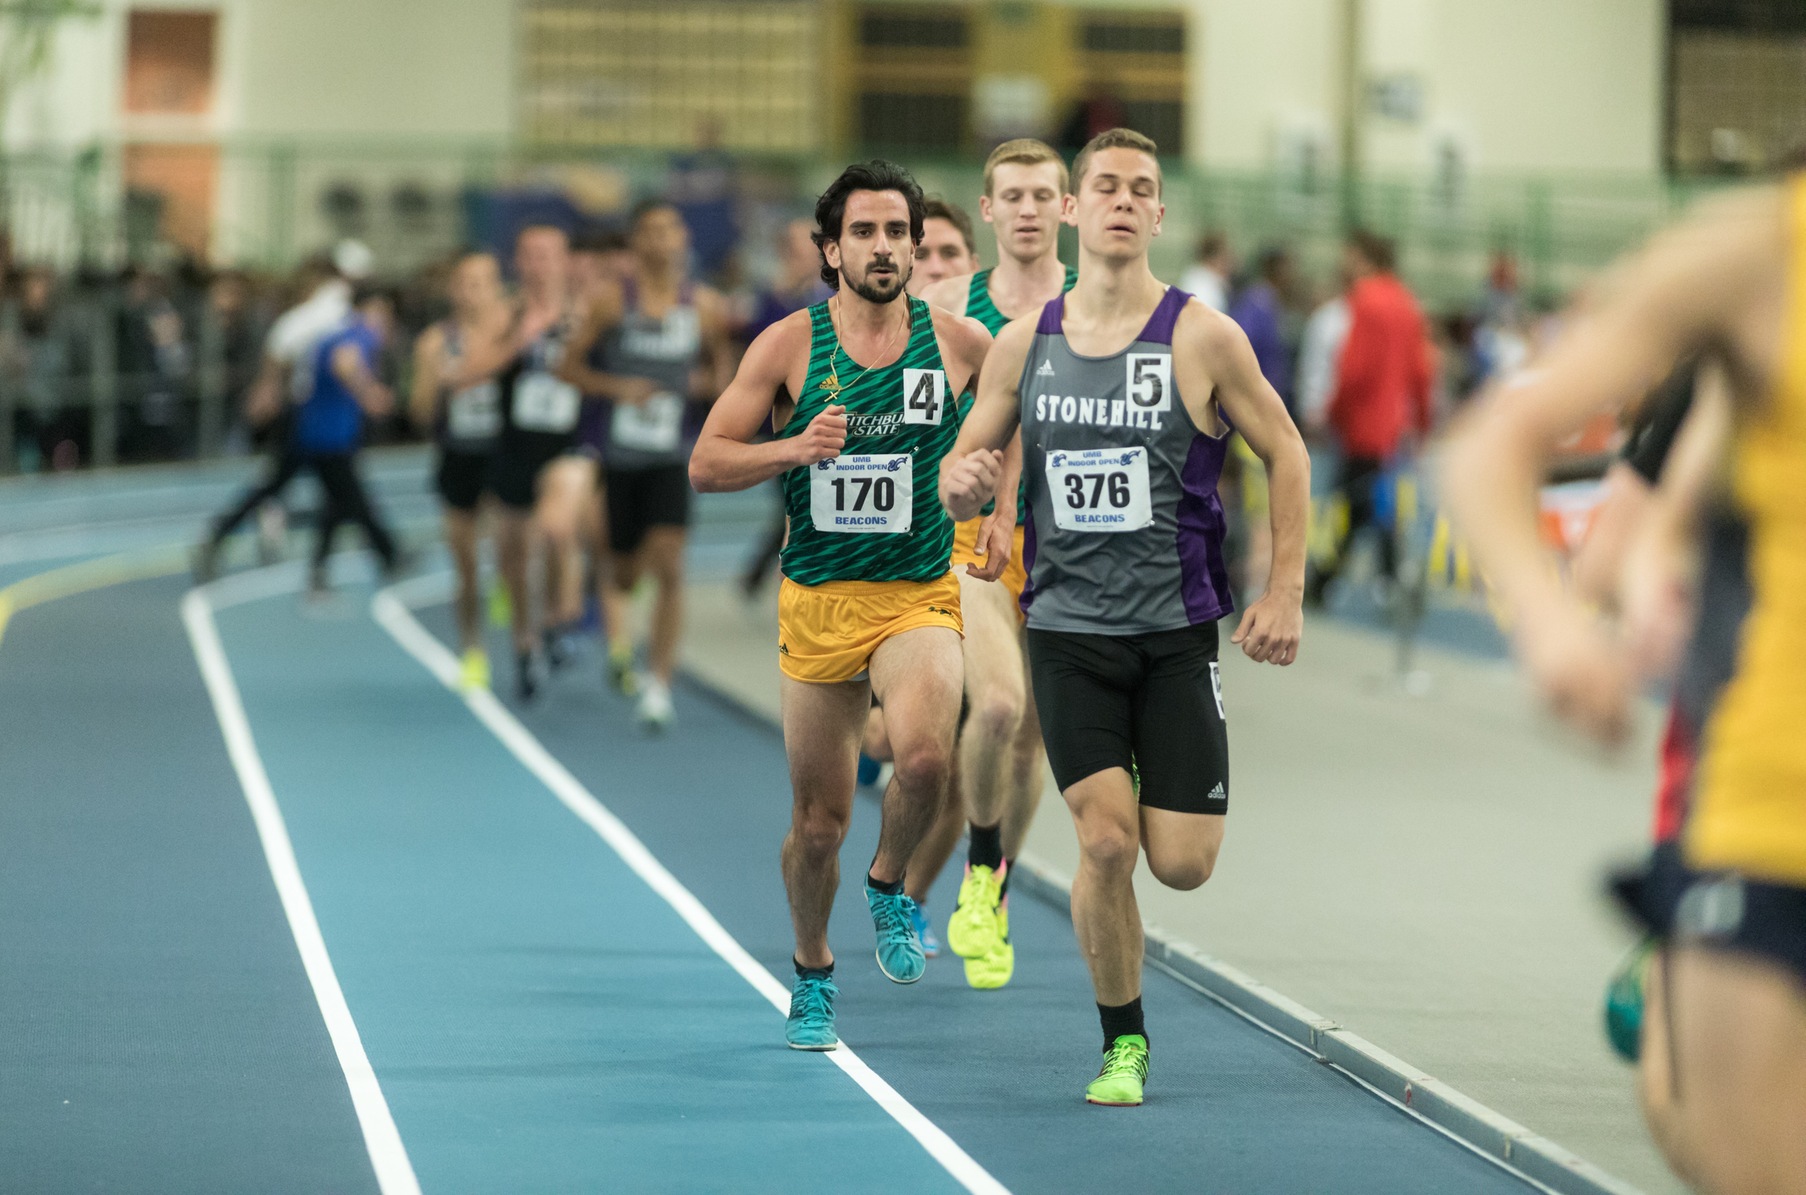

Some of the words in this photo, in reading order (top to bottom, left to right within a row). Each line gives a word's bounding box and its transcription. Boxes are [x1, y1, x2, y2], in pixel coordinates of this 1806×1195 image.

[909, 373, 938, 420] 4
[1132, 358, 1163, 407] 5
[854, 424, 900, 436] STATE
[1036, 394, 1163, 430] STONEHILL
[1068, 459, 1096, 467] INDOOR
[1099, 458, 1120, 466] OPEN
[831, 476, 895, 512] 170
[1064, 471, 1131, 509] 376
[835, 516, 887, 525] BEACONS
[1074, 513, 1126, 523] BEACONS
